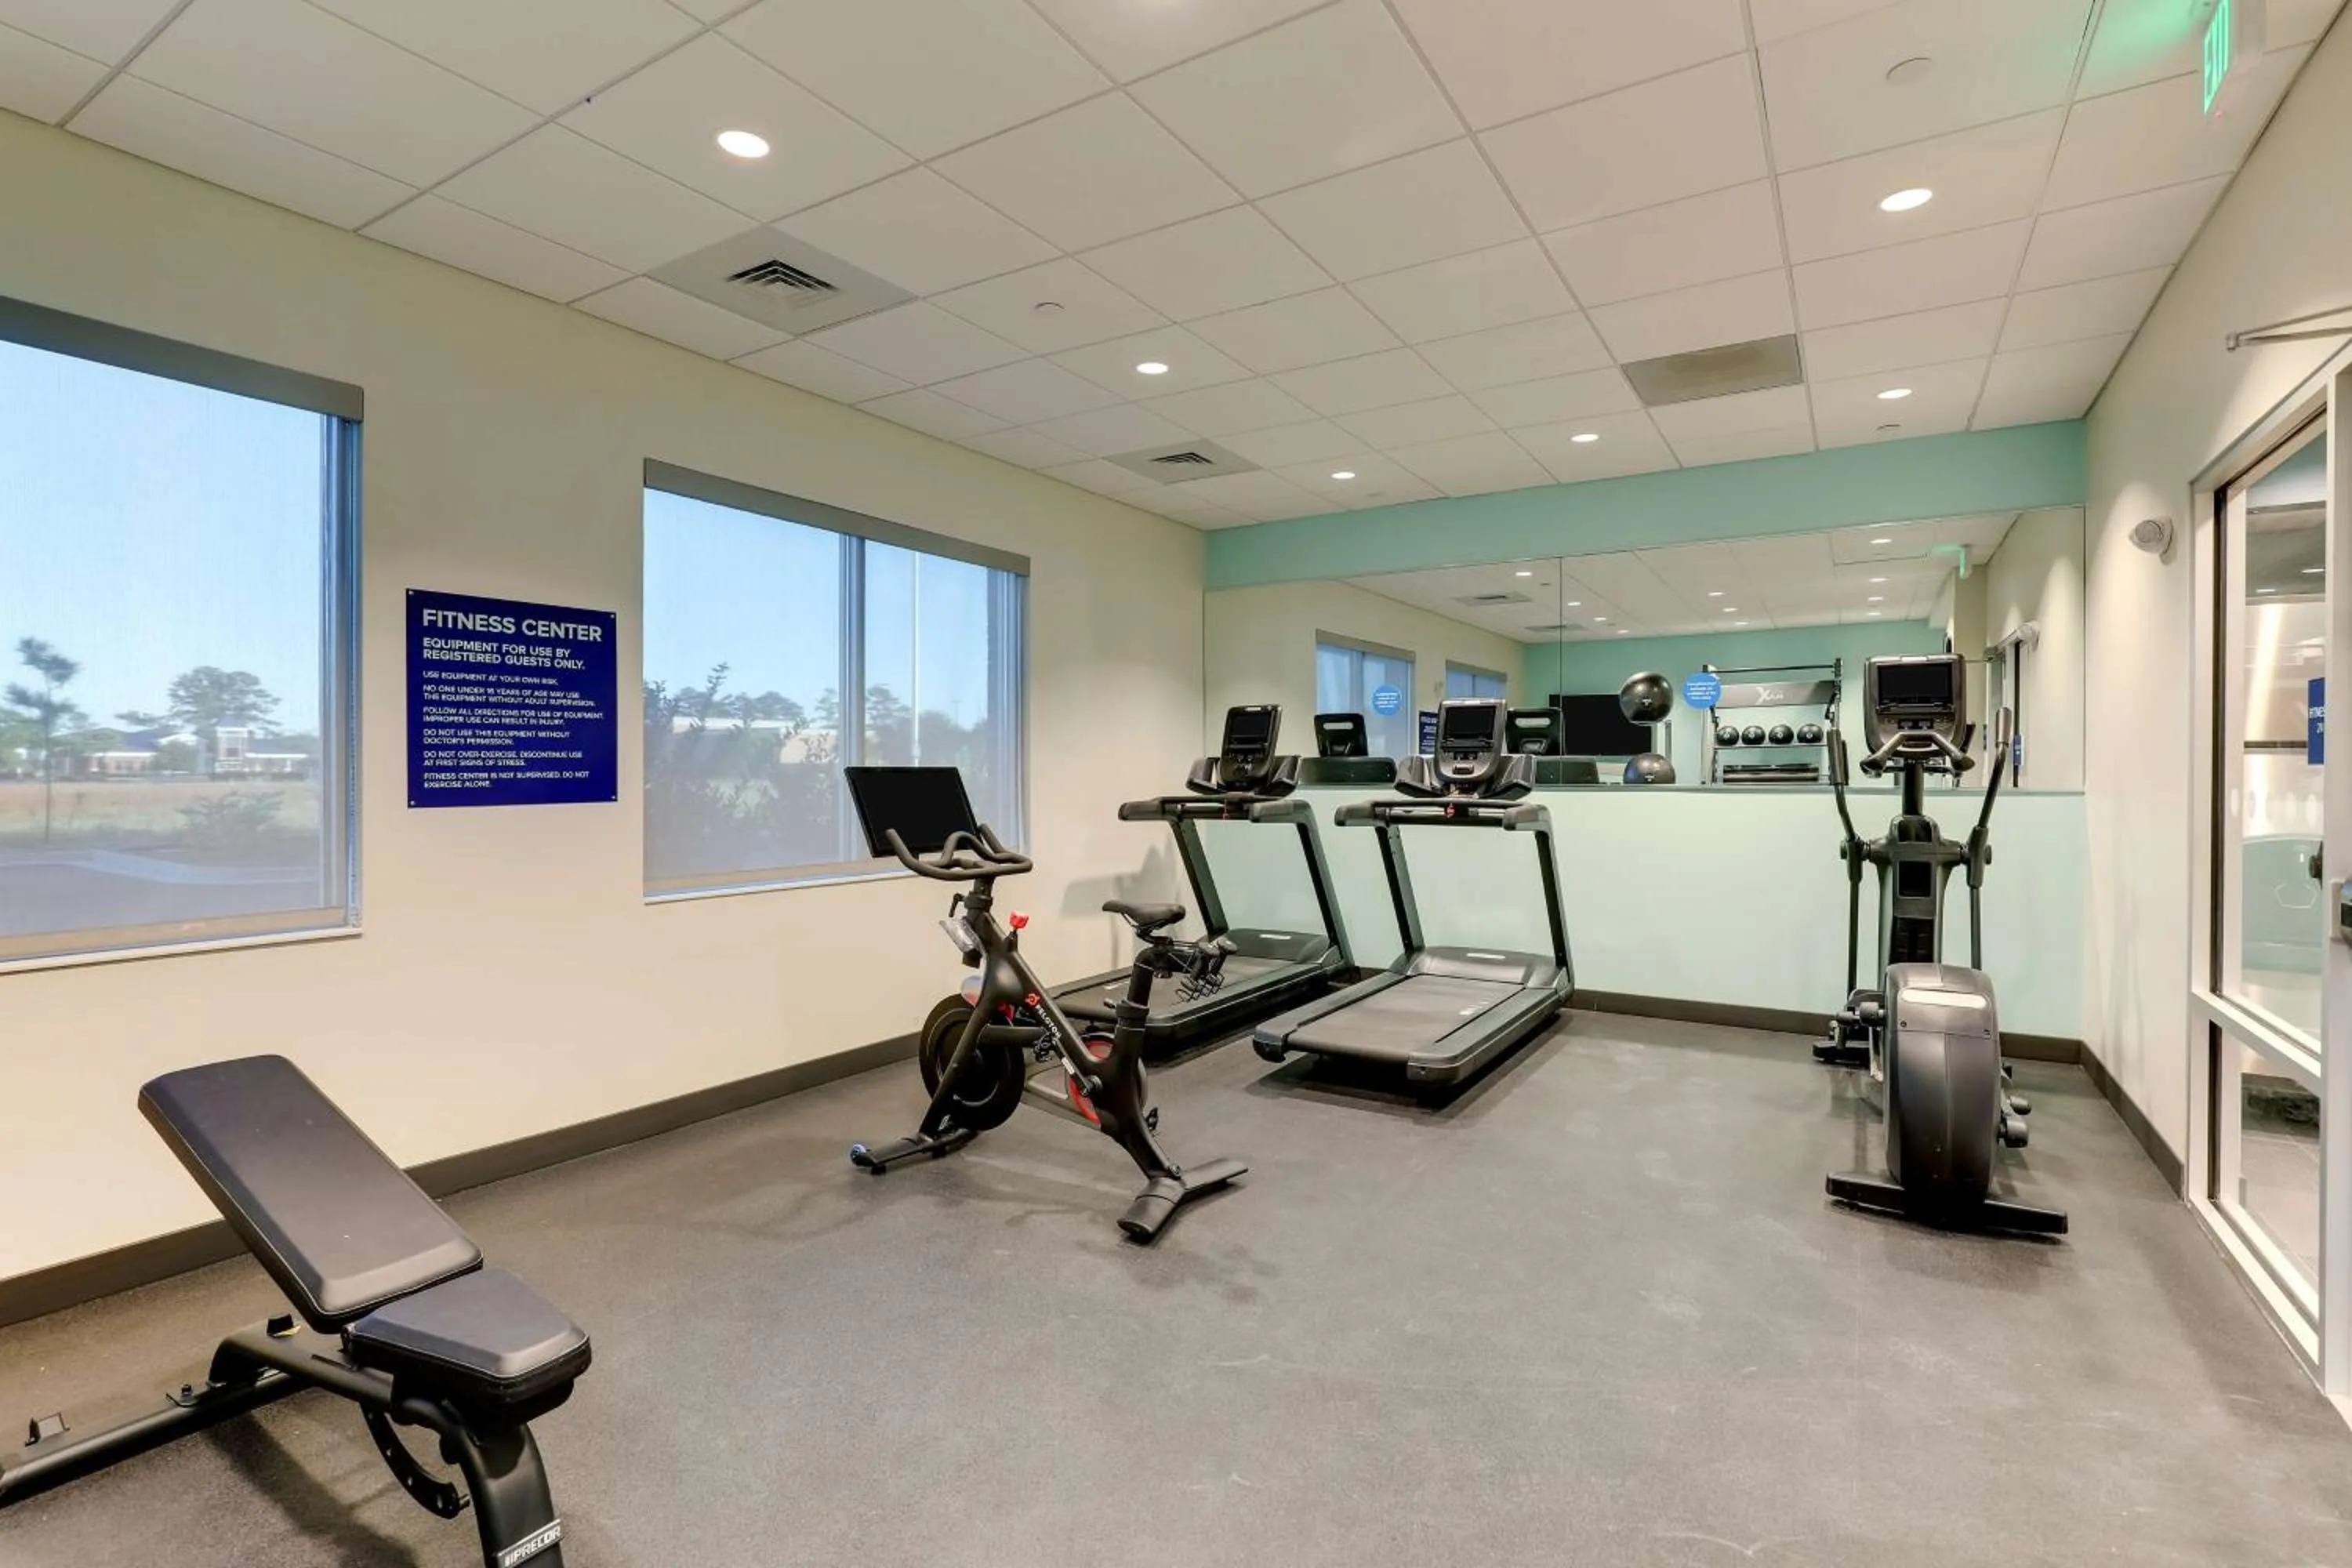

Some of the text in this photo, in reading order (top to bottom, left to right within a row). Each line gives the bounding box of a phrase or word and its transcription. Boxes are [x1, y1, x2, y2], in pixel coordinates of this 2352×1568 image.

[423, 608, 602, 642] FITNESS CENTER
[423, 637, 571, 658] EQUIPMENT FOR USE BY
[423, 649, 586, 670] REGISTERED GUESTS ONLY.
[441, 672, 486, 681] EQUIPMENT
[488, 695, 523, 704] WITHOUT
[423, 714, 464, 723] IMPROPER
[474, 708, 518, 717] DIRECTIONS
[514, 1524, 561, 1563] PRECOR
